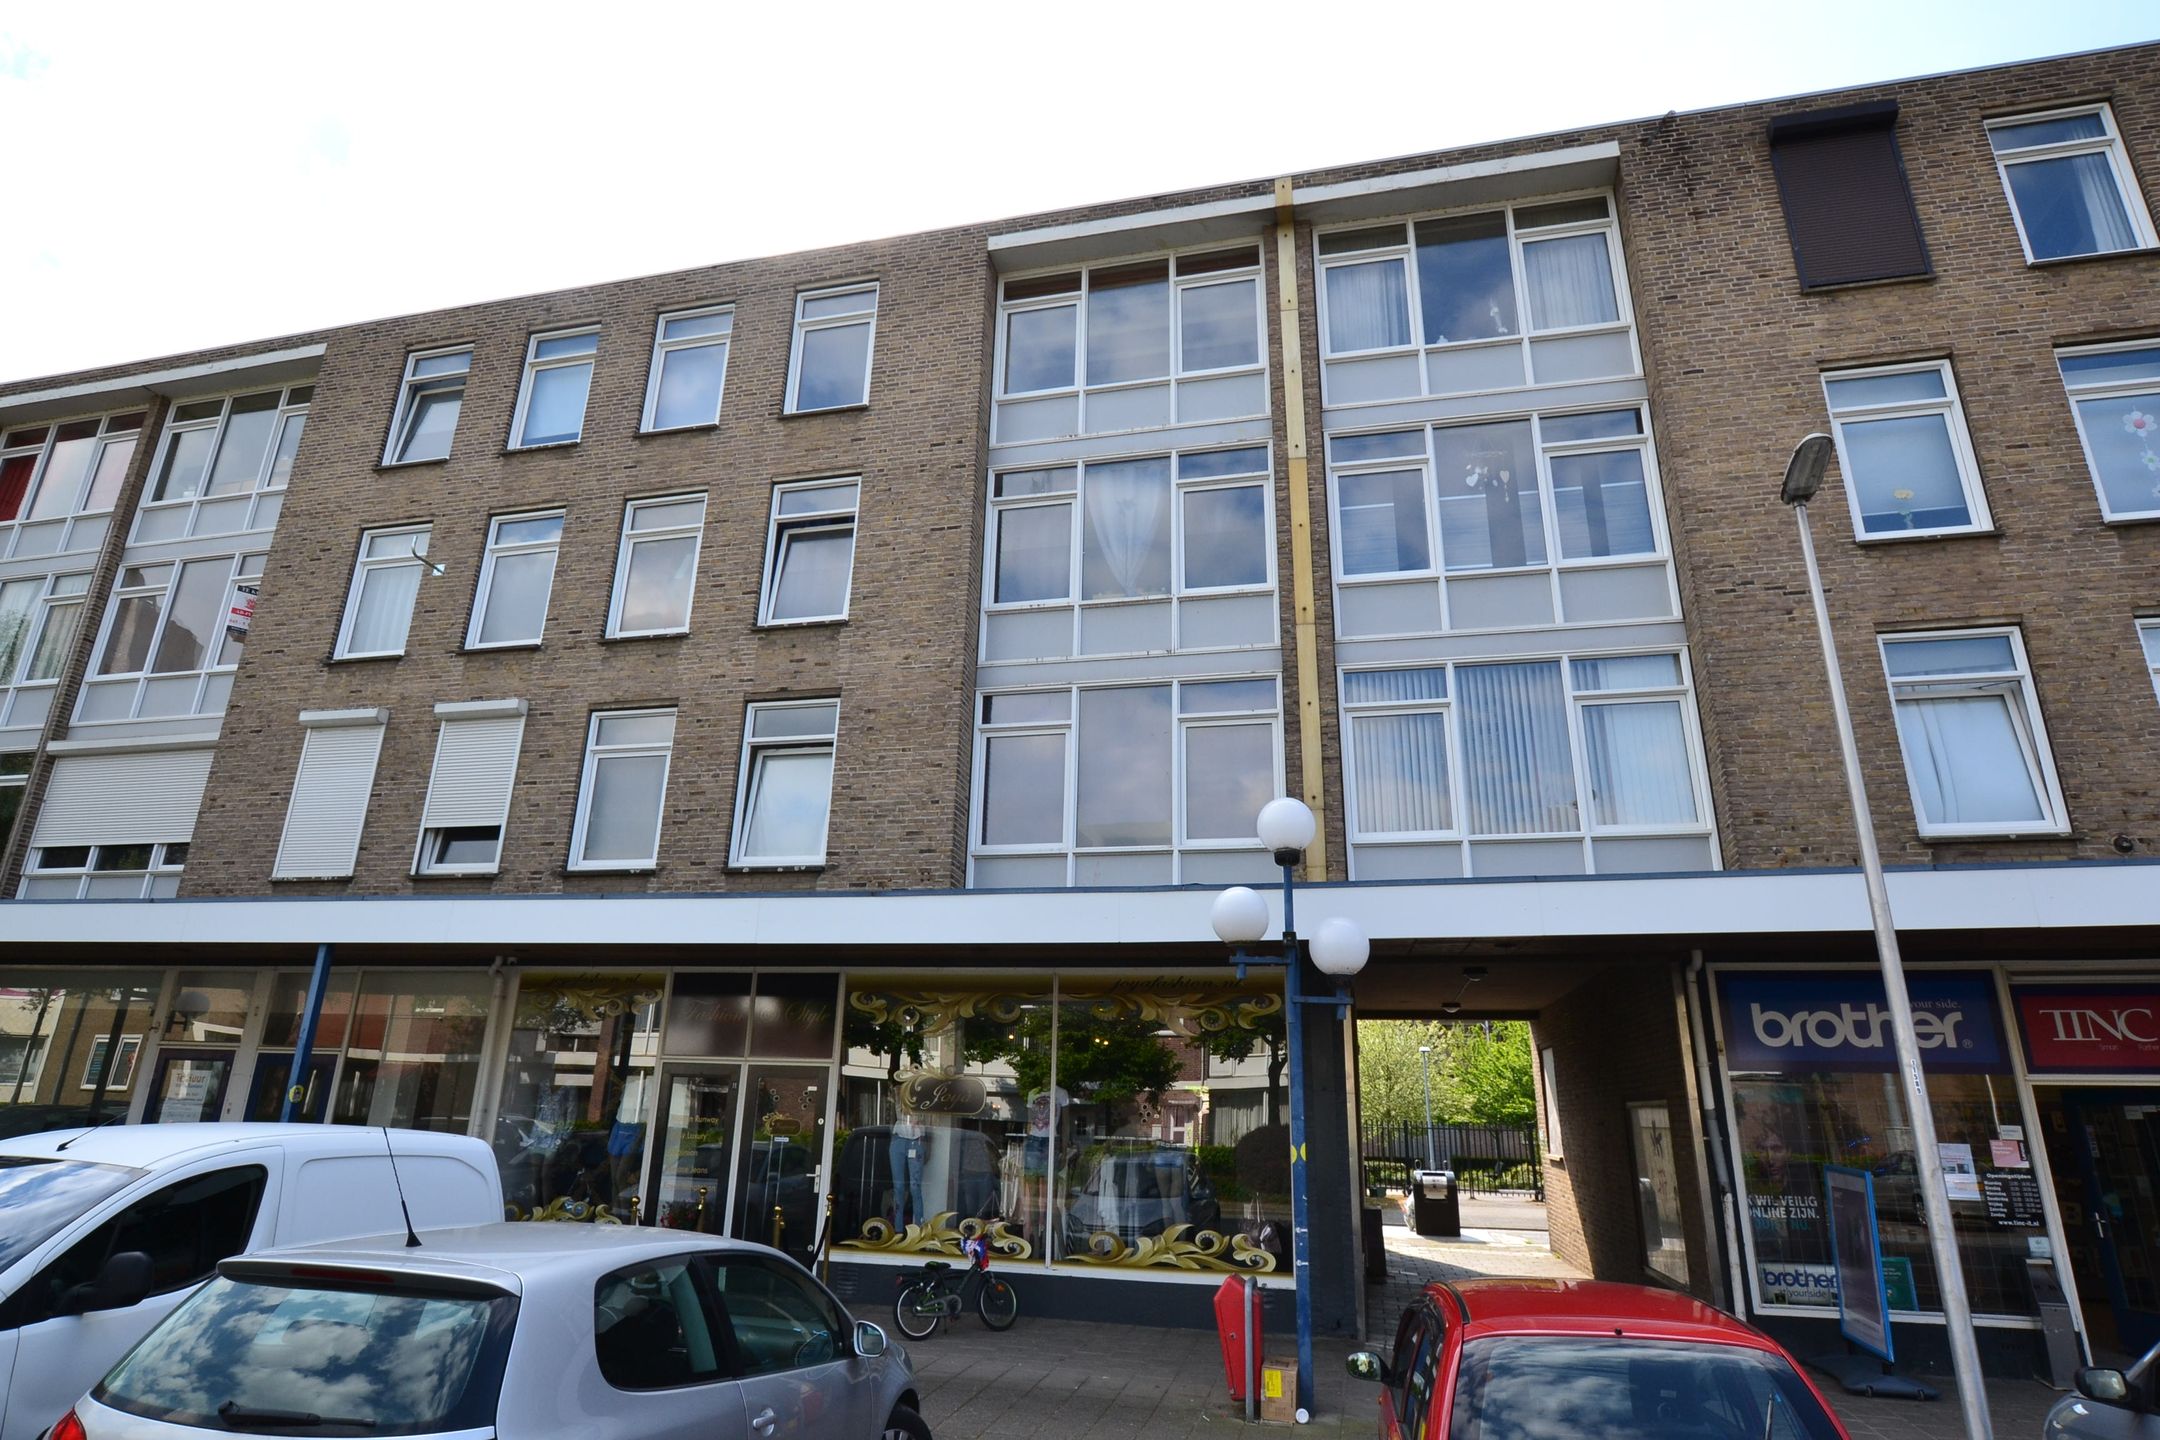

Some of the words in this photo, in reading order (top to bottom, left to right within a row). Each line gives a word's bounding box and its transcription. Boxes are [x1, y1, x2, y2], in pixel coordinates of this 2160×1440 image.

[1935, 998, 1962, 1010] side.
[1750, 1002, 1963, 1049] brother
[920, 1081, 970, 1110] Joya
[1779, 1195, 1818, 1207] VEILIG
[1789, 1208, 1820, 1219] ZIJN.
[1763, 1268, 1837, 1288] brother
